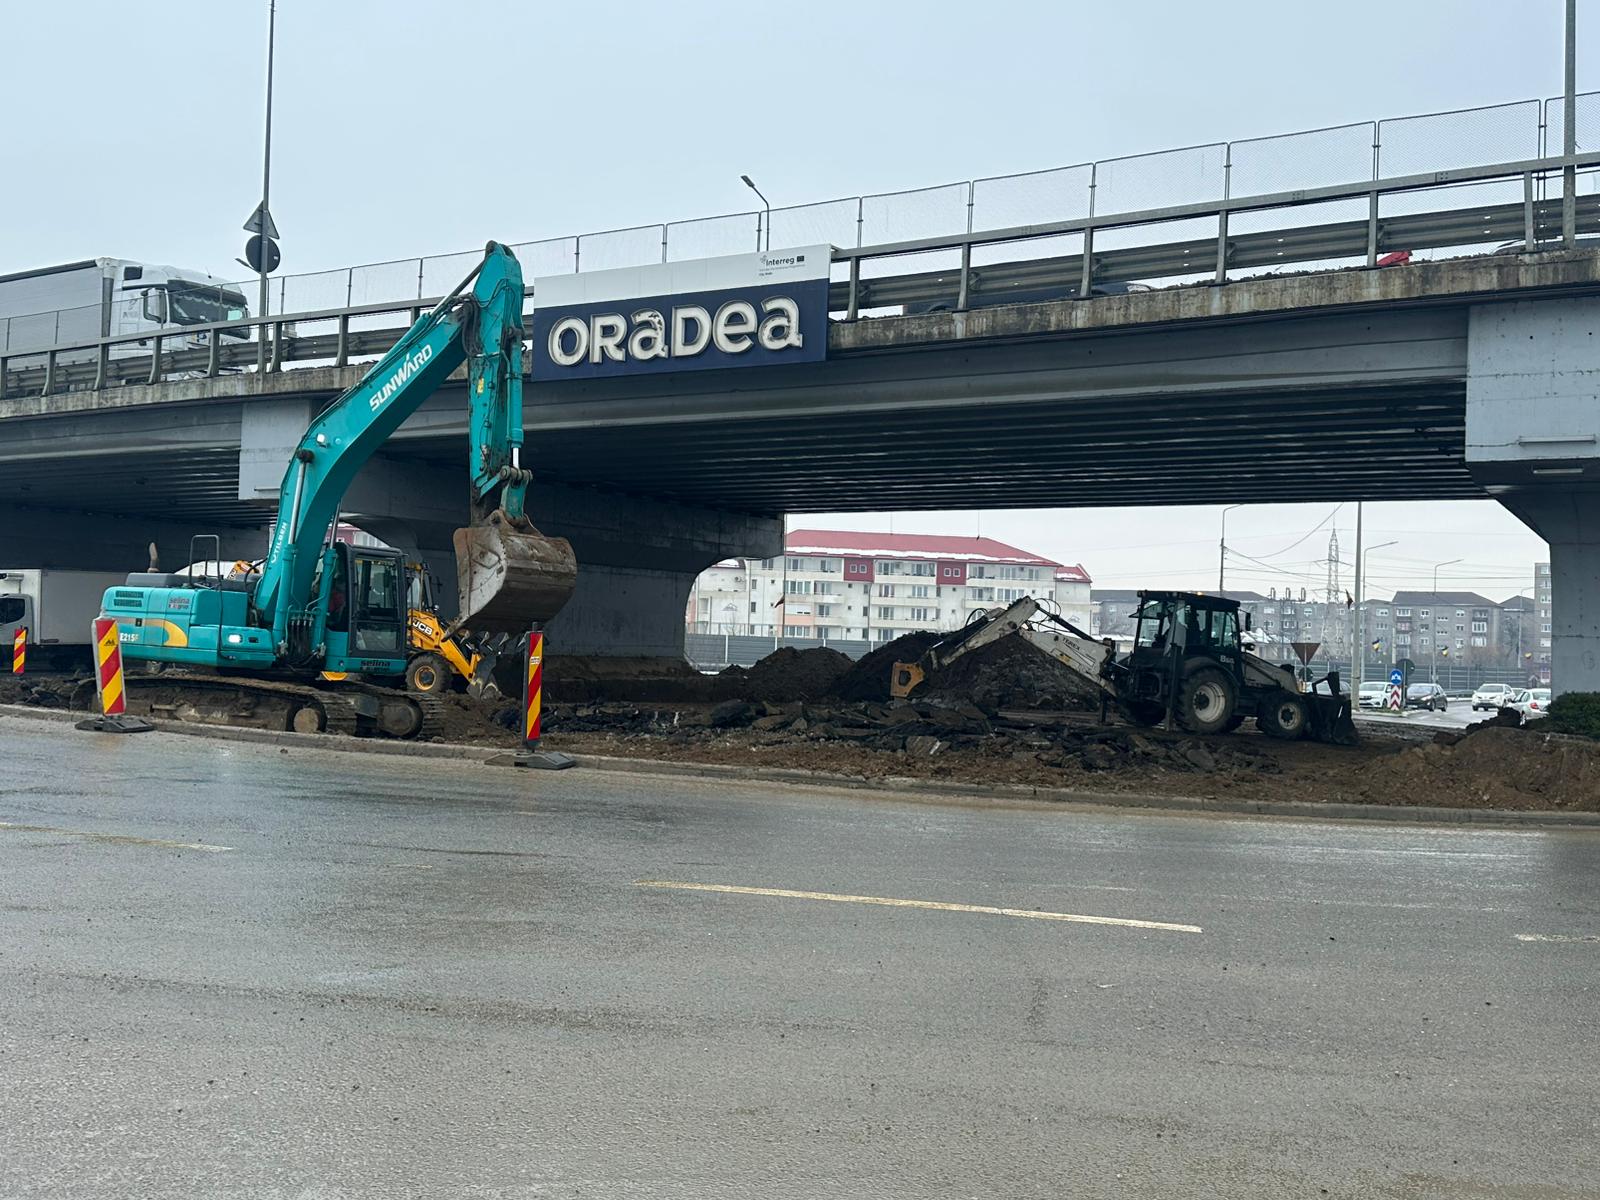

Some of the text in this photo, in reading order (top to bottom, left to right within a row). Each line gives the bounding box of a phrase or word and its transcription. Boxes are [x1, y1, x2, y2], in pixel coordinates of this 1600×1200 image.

[766, 257, 795, 266] Interreg
[369, 344, 433, 412] SUNWARD
[412, 620, 433, 636] JCB
